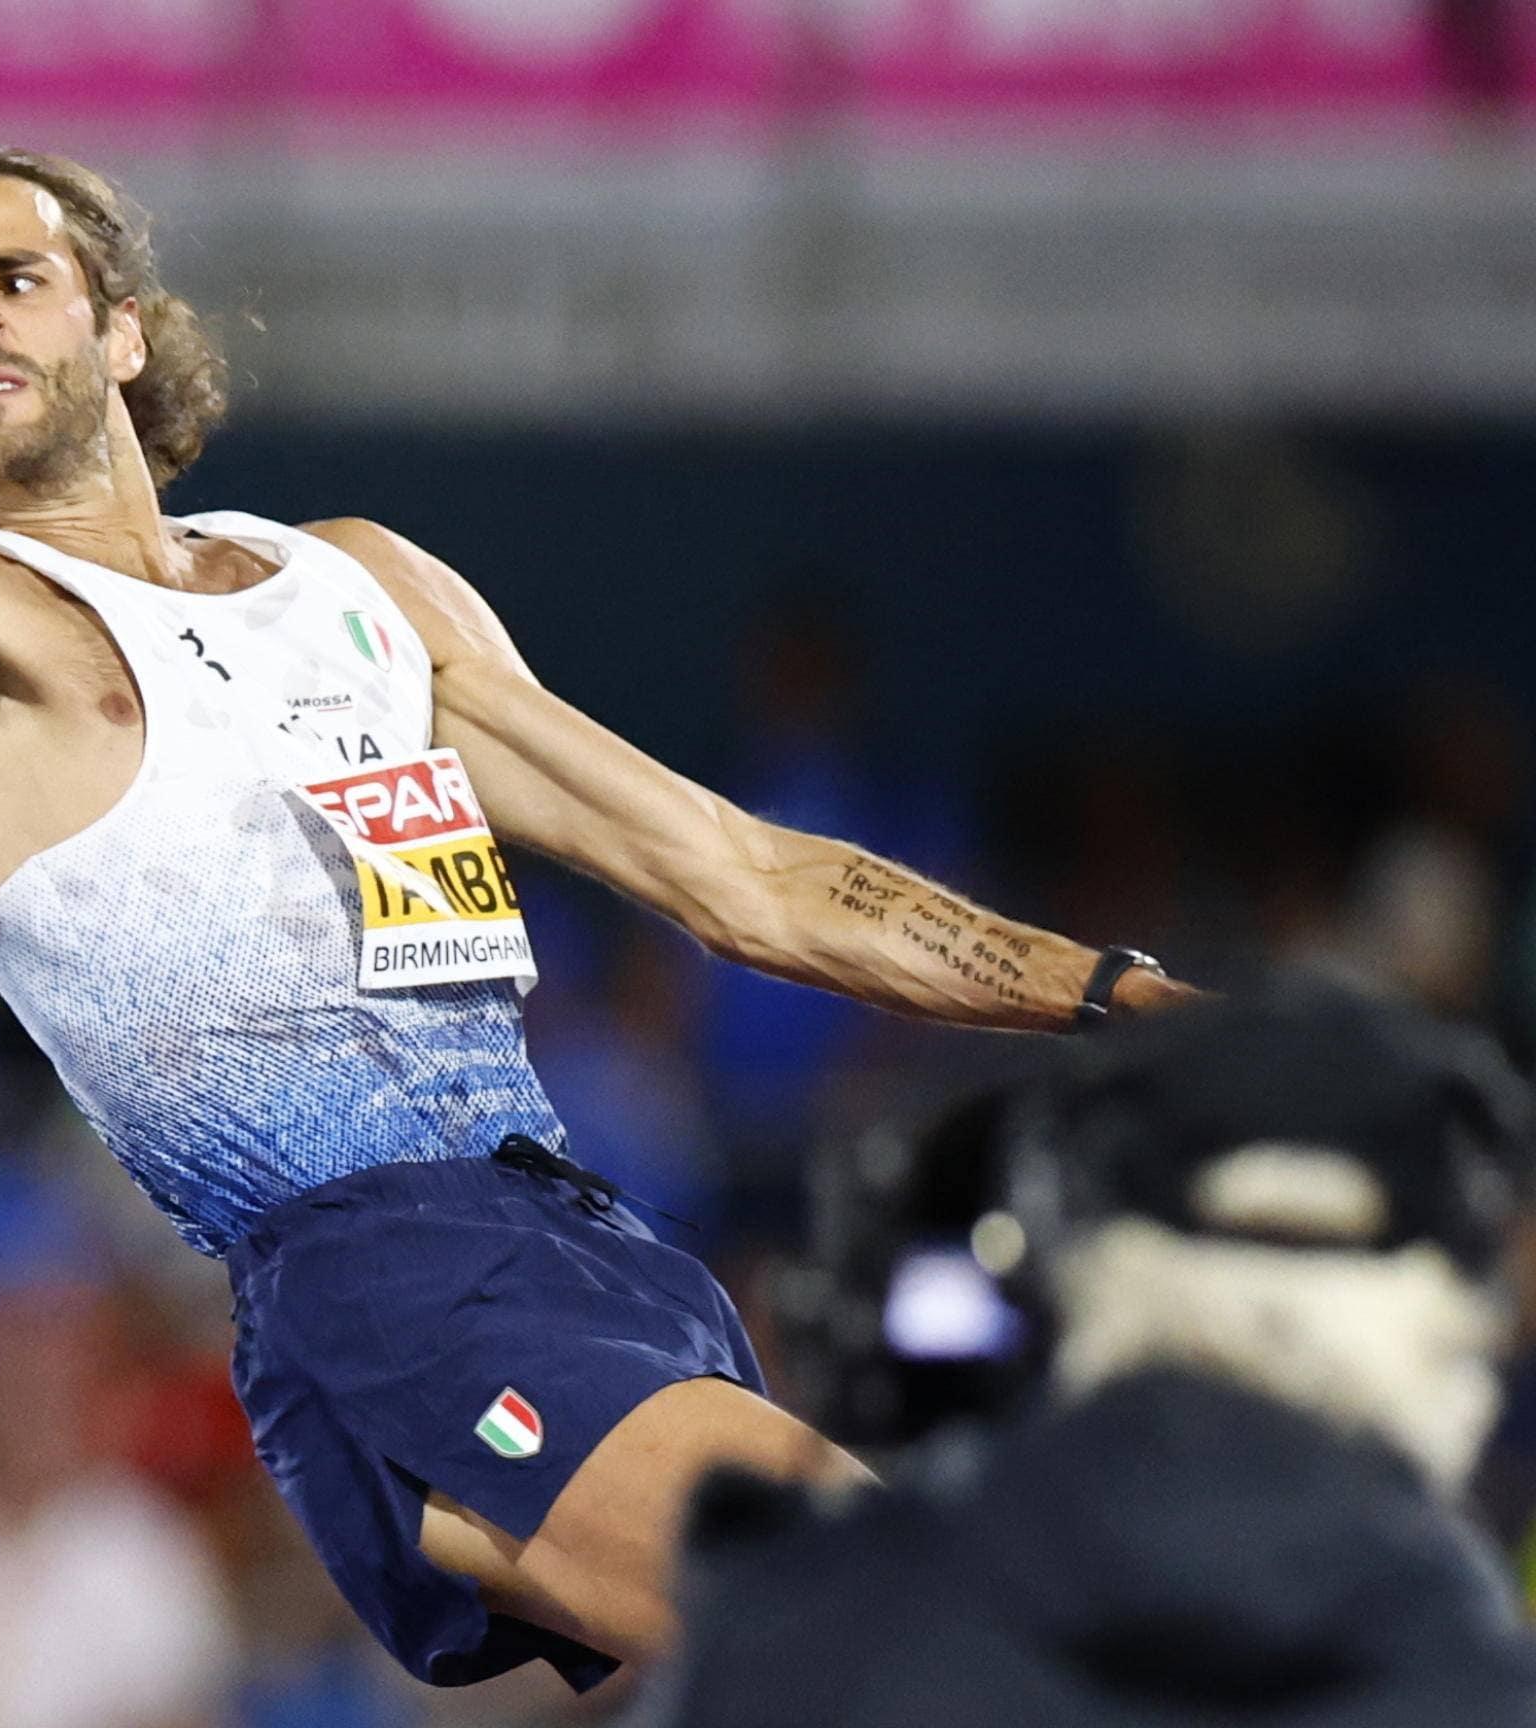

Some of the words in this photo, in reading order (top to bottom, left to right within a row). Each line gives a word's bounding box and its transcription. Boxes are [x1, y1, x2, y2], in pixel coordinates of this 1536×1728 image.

[312, 768, 479, 838] SPAR
[828, 886, 888, 921] TRUST
[842, 864, 905, 901] TRUST
[911, 902, 962, 942] YOUR
[972, 941, 1024, 980] BODY
